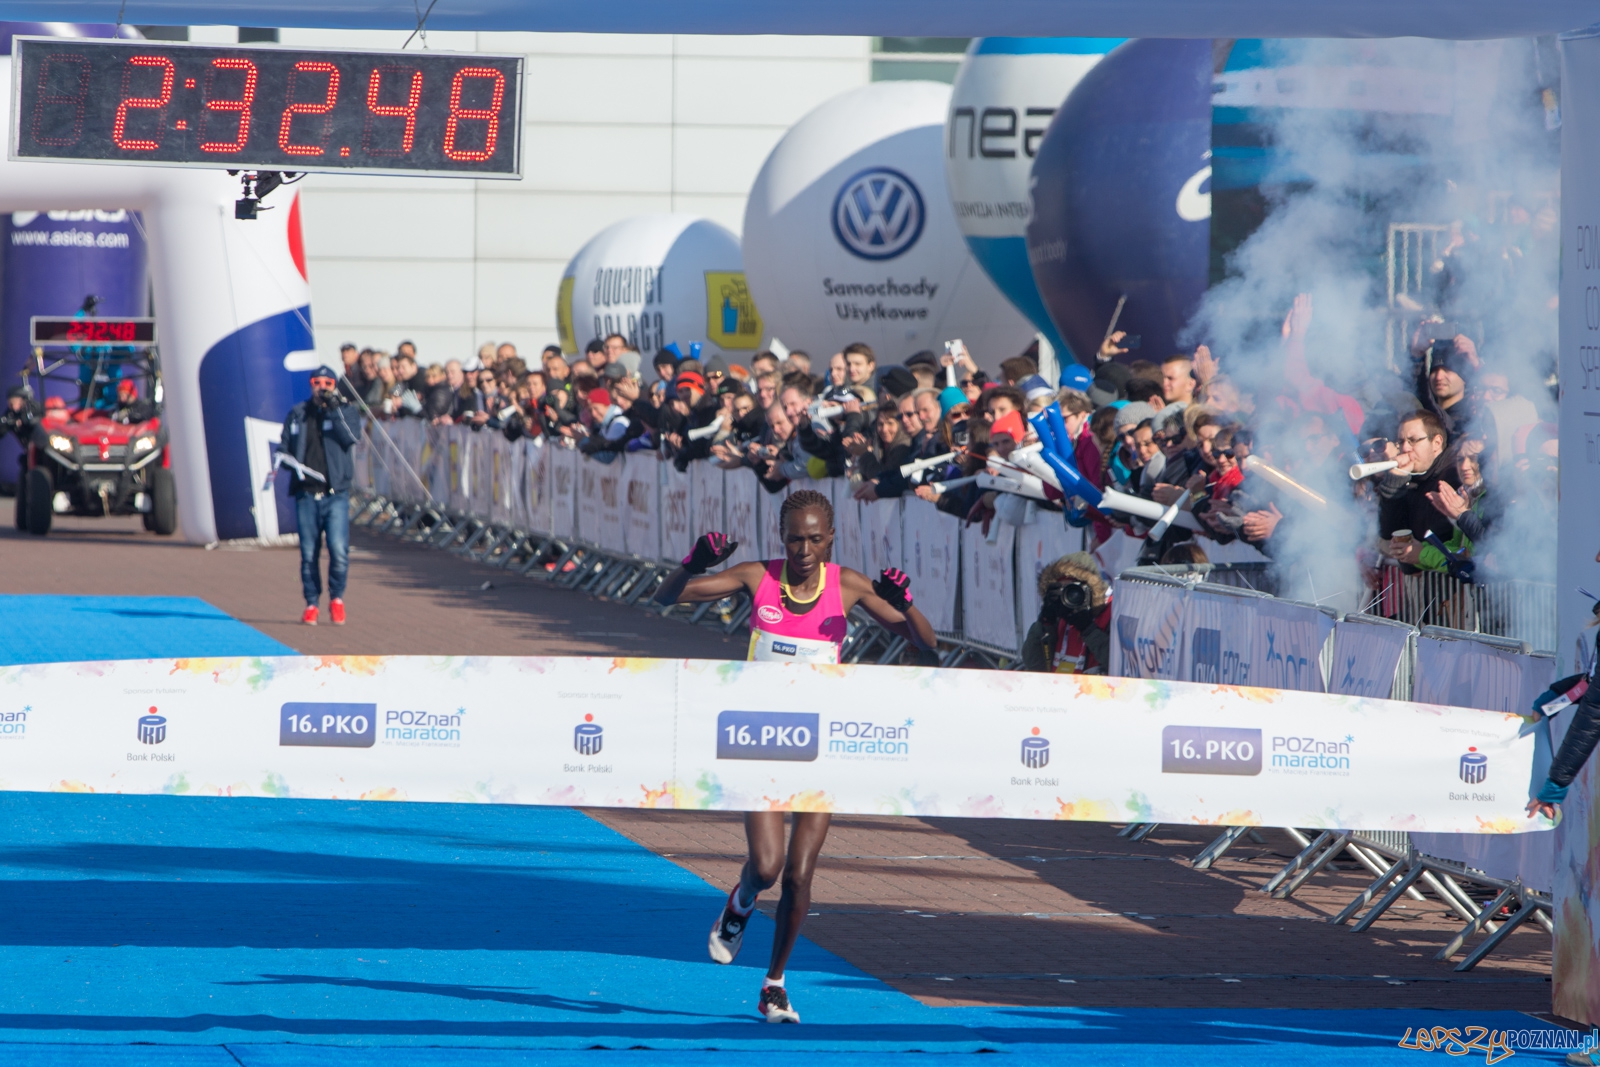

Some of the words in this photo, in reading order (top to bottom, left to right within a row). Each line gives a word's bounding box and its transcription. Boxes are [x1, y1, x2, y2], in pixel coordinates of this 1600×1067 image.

[11, 229, 130, 248] www.asics.com
[823, 276, 939, 299] Samochody
[836, 303, 928, 324] Użytkowe
[288, 714, 317, 733] 16.
[322, 715, 369, 734] PKO
[385, 726, 461, 740] maraton
[725, 725, 757, 745] 16.
[760, 725, 811, 747] PKO
[829, 738, 909, 754] maraton
[1170, 739, 1202, 759] 16.
[1205, 740, 1254, 761] PKO
[126, 753, 148, 762] Bank
[150, 753, 175, 762] Polski
[1272, 753, 1350, 769] maraton
[563, 763, 585, 772] Bank
[587, 764, 613, 773] Polski
[1010, 777, 1032, 786] Bank
[1035, 777, 1059, 787] Polski
[1449, 792, 1469, 801] Bank
[1472, 792, 1495, 801] Polski
